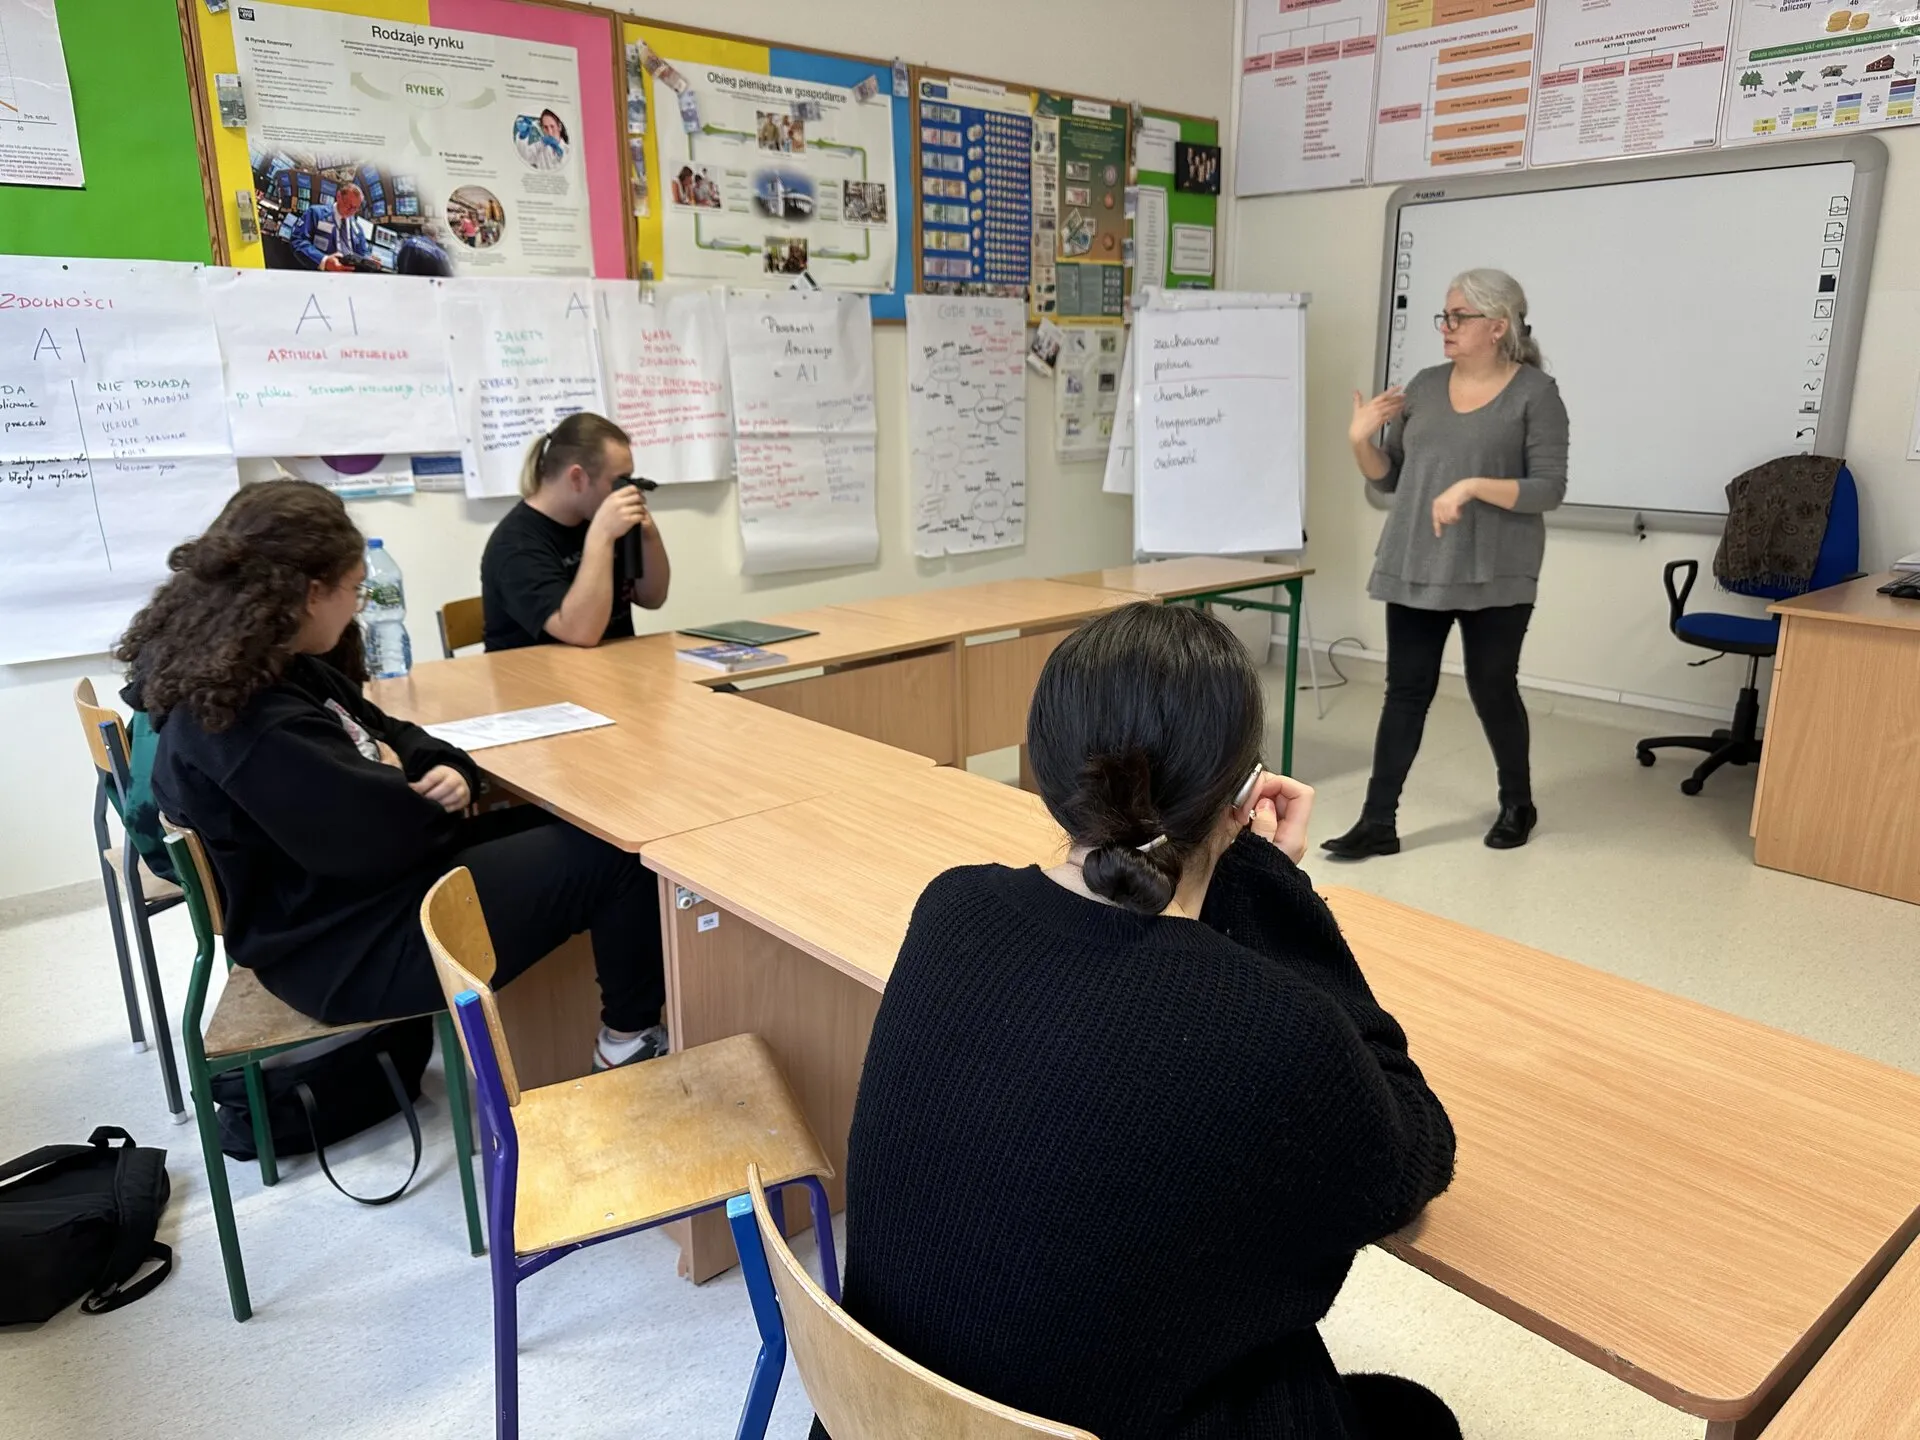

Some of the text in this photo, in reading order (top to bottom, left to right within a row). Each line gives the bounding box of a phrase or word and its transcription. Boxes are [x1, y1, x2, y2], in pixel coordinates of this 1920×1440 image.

[1779, 1, 1812, 13] naliczony
[370, 25, 465, 51] Rodzaje rynku
[1574, 22, 1690, 47] KLASYFIKACJA AKTYWÓW OBROTOWYCH
[1603, 36, 1657, 49] AKTYWA OBROTOWE
[266, 40, 293, 48] finansowy
[405, 83, 445, 98] RYNEK
[706, 72, 738, 89] Obieg
[739, 78, 783, 95] pieniądza
[784, 84, 793, 94] w
[0, 291, 114, 310] ZDOLNOŚCI
[97, 378, 190, 392] NIE POSIADA
[96, 396, 131, 415] MYŚLI
[236, 390, 250, 408] po
